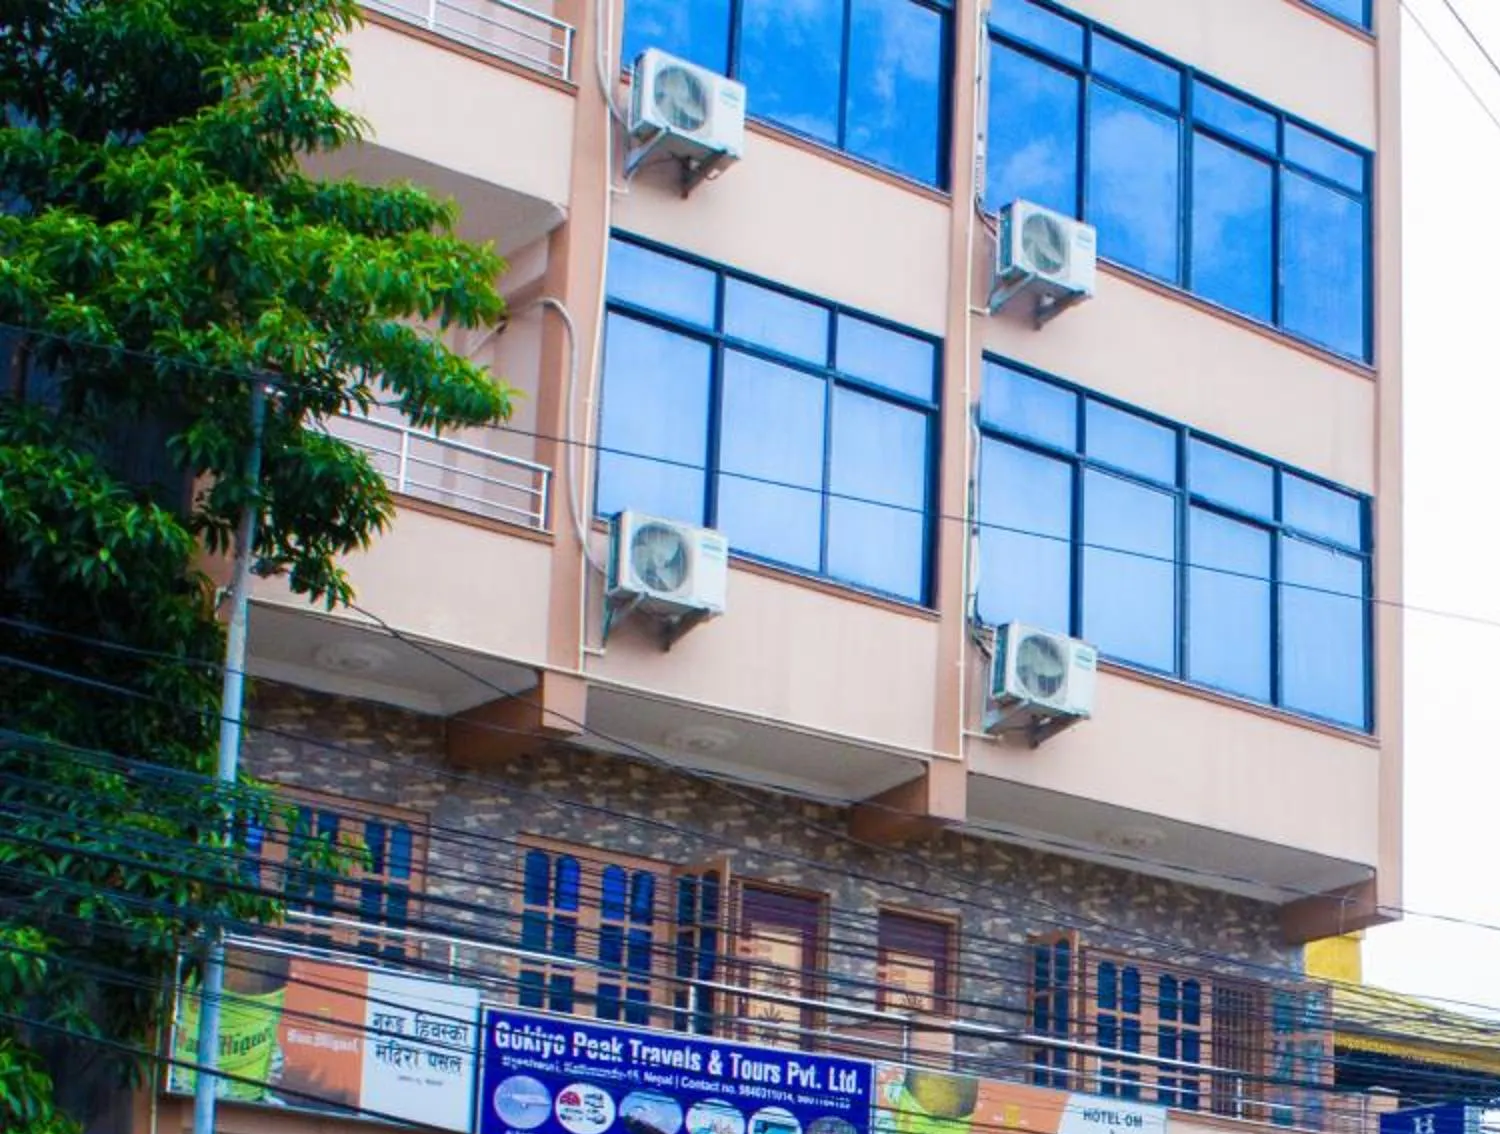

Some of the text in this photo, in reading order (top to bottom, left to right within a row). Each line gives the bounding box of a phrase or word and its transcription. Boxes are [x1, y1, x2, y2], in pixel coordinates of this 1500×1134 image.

[495, 1020, 863, 1096] Gokiyo Peak Travels & Tours Pvt. Ltd.
[681, 1076, 720, 1092] Contact
[1082, 1107, 1120, 1125] HOTEL
